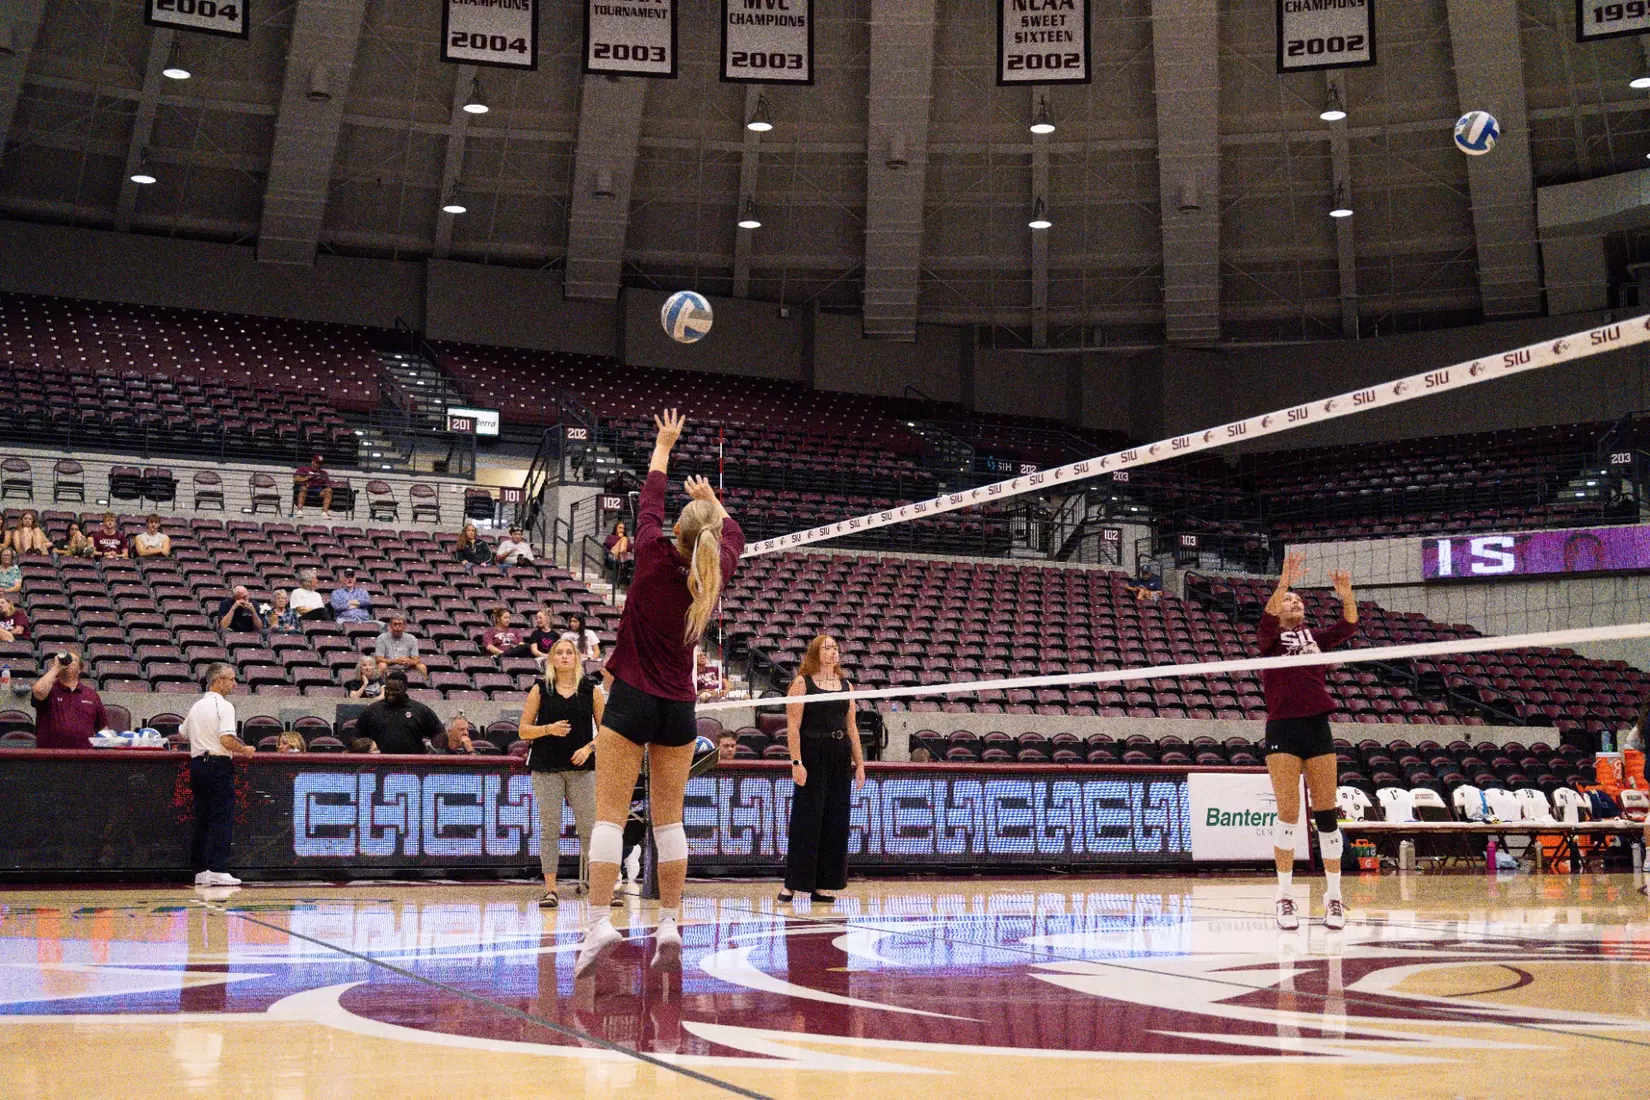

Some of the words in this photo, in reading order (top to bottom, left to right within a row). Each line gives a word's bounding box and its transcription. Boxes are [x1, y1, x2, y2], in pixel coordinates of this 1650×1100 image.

[157, 0, 239, 21] 2004
[594, 4, 668, 19] TOURNAMENT
[743, 0, 789, 10] MVC
[1013, 0, 1074, 11] NCAA
[1593, 1, 1650, 23] 199
[729, 13, 805, 27] CHAMPIONS
[1021, 14, 1066, 27] SWEET
[451, 31, 527, 54] 2004
[1014, 30, 1073, 43] SIXTEEN
[1288, 35, 1364, 56] 2002
[594, 43, 666, 62] 2003
[732, 51, 803, 69] 2003
[1007, 53, 1080, 70] 2002
[452, 418, 470, 430] 201
[881, 513, 892, 522] SIU
[914, 503, 927, 513] SIU
[950, 492, 963, 505] SIU
[988, 484, 1002, 496] SIU
[1029, 473, 1044, 486] SIU
[1073, 462, 1089, 476] SIU
[1120, 450, 1138, 463] SIU
[1171, 436, 1190, 450] SIU
[1227, 422, 1247, 437] SIU
[1287, 407, 1308, 422] SIU
[1353, 390, 1376, 406] SIU
[1424, 370, 1449, 388] SIU
[1503, 350, 1531, 369] SIU
[1590, 326, 1621, 346] SIU
[567, 428, 587, 440] 202
[1611, 452, 1632, 464] 203
[1113, 471, 1129, 482] 203
[504, 489, 520, 502] 101
[603, 496, 621, 509] 102
[1103, 529, 1119, 541] 102
[1181, 535, 1196, 546] 103
